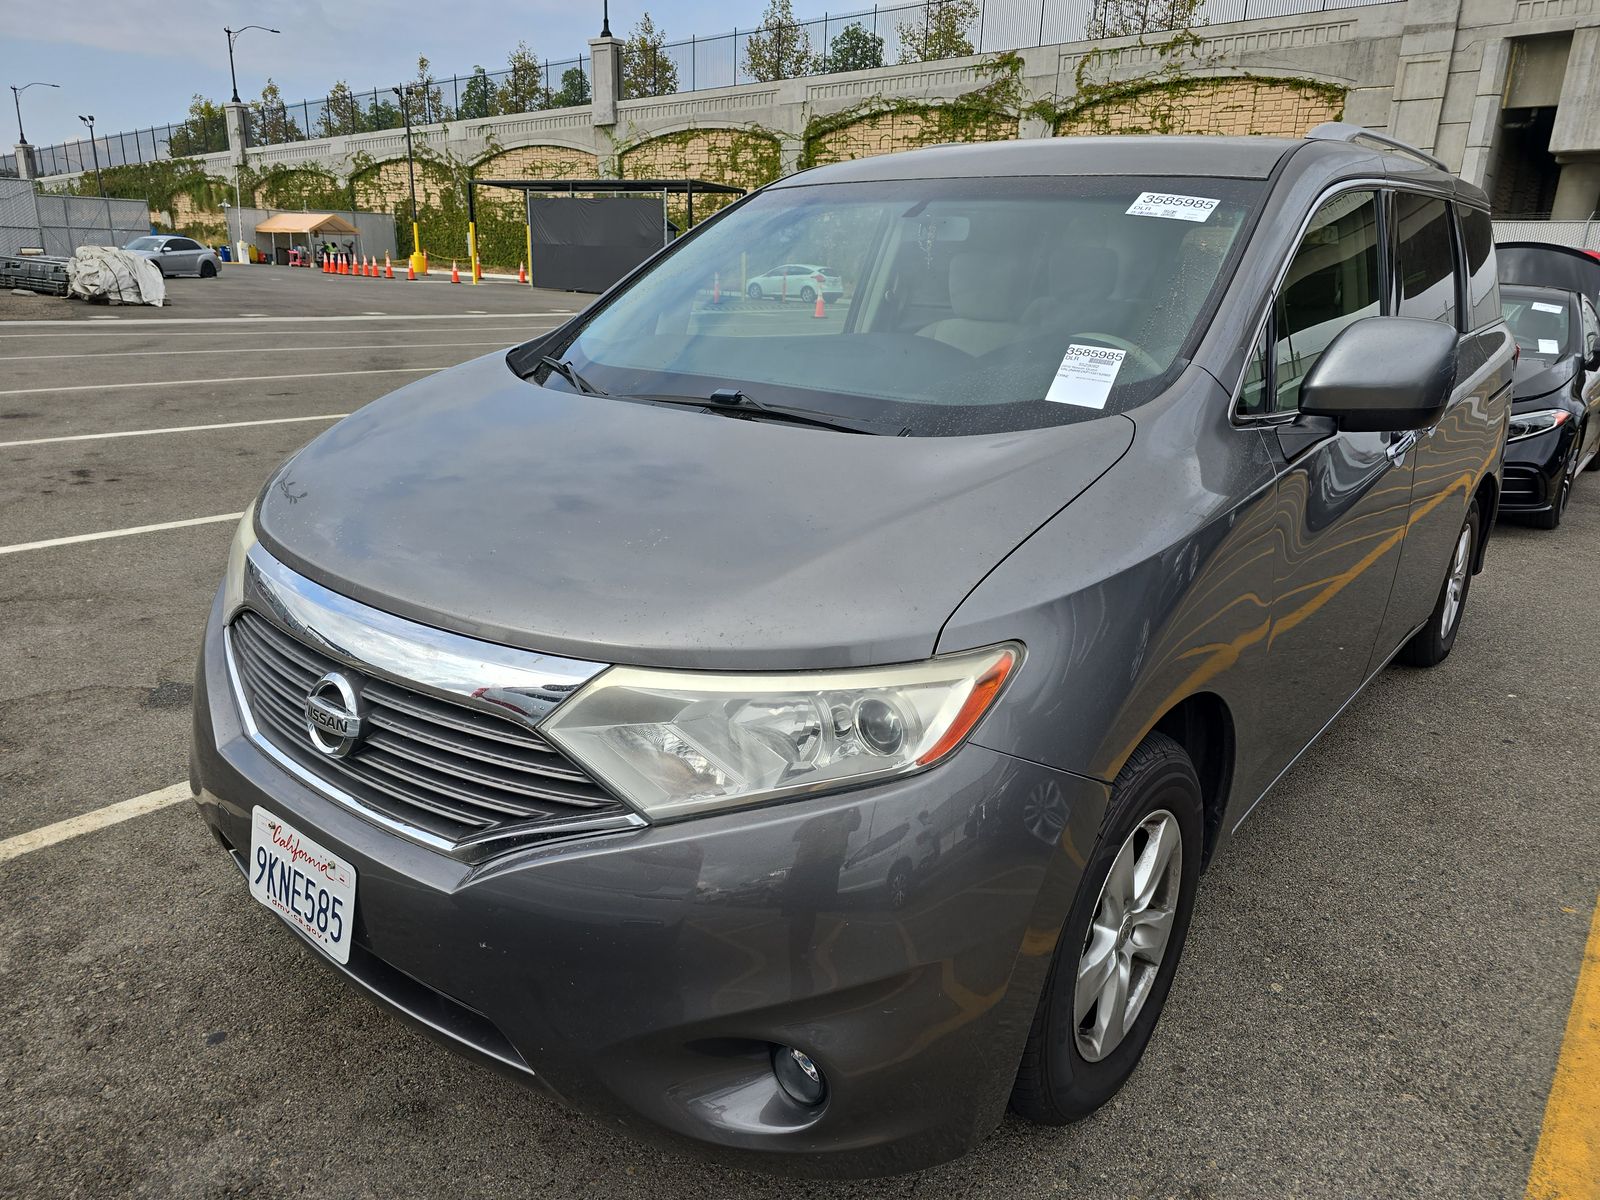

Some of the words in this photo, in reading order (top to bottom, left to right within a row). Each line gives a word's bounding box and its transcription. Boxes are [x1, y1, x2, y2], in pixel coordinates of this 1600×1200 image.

[1143, 195, 1216, 210] 3585985
[1066, 347, 1123, 361] 3585985
[272, 825, 334, 882] California
[255, 846, 343, 943] 9KNE585
[271, 898, 323, 940] dmv.ca.gov
